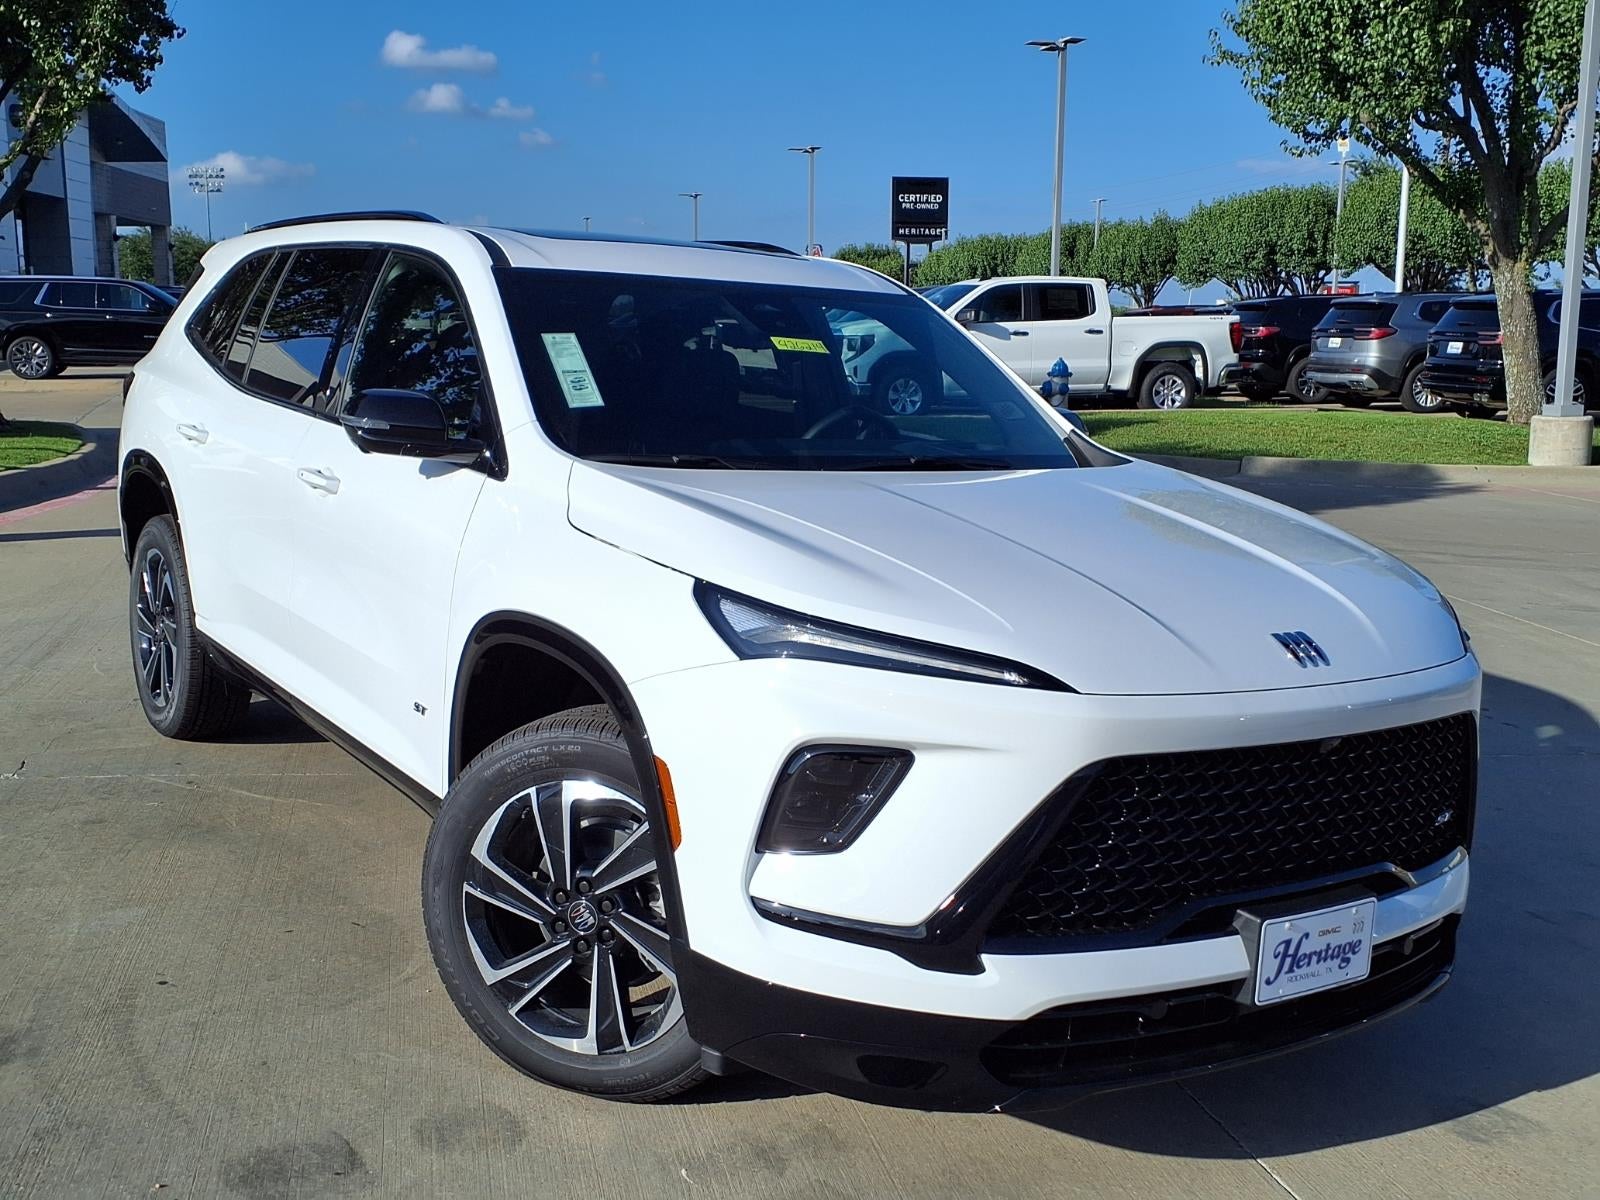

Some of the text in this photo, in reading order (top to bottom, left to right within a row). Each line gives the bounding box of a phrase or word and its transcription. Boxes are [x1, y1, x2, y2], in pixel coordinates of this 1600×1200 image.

[898, 193, 943, 203] CERTIFIED
[898, 227, 942, 236] HERITAGE
[412, 701, 429, 717] ST
[1318, 926, 1342, 937] GMC
[1264, 931, 1363, 986] Heritage
